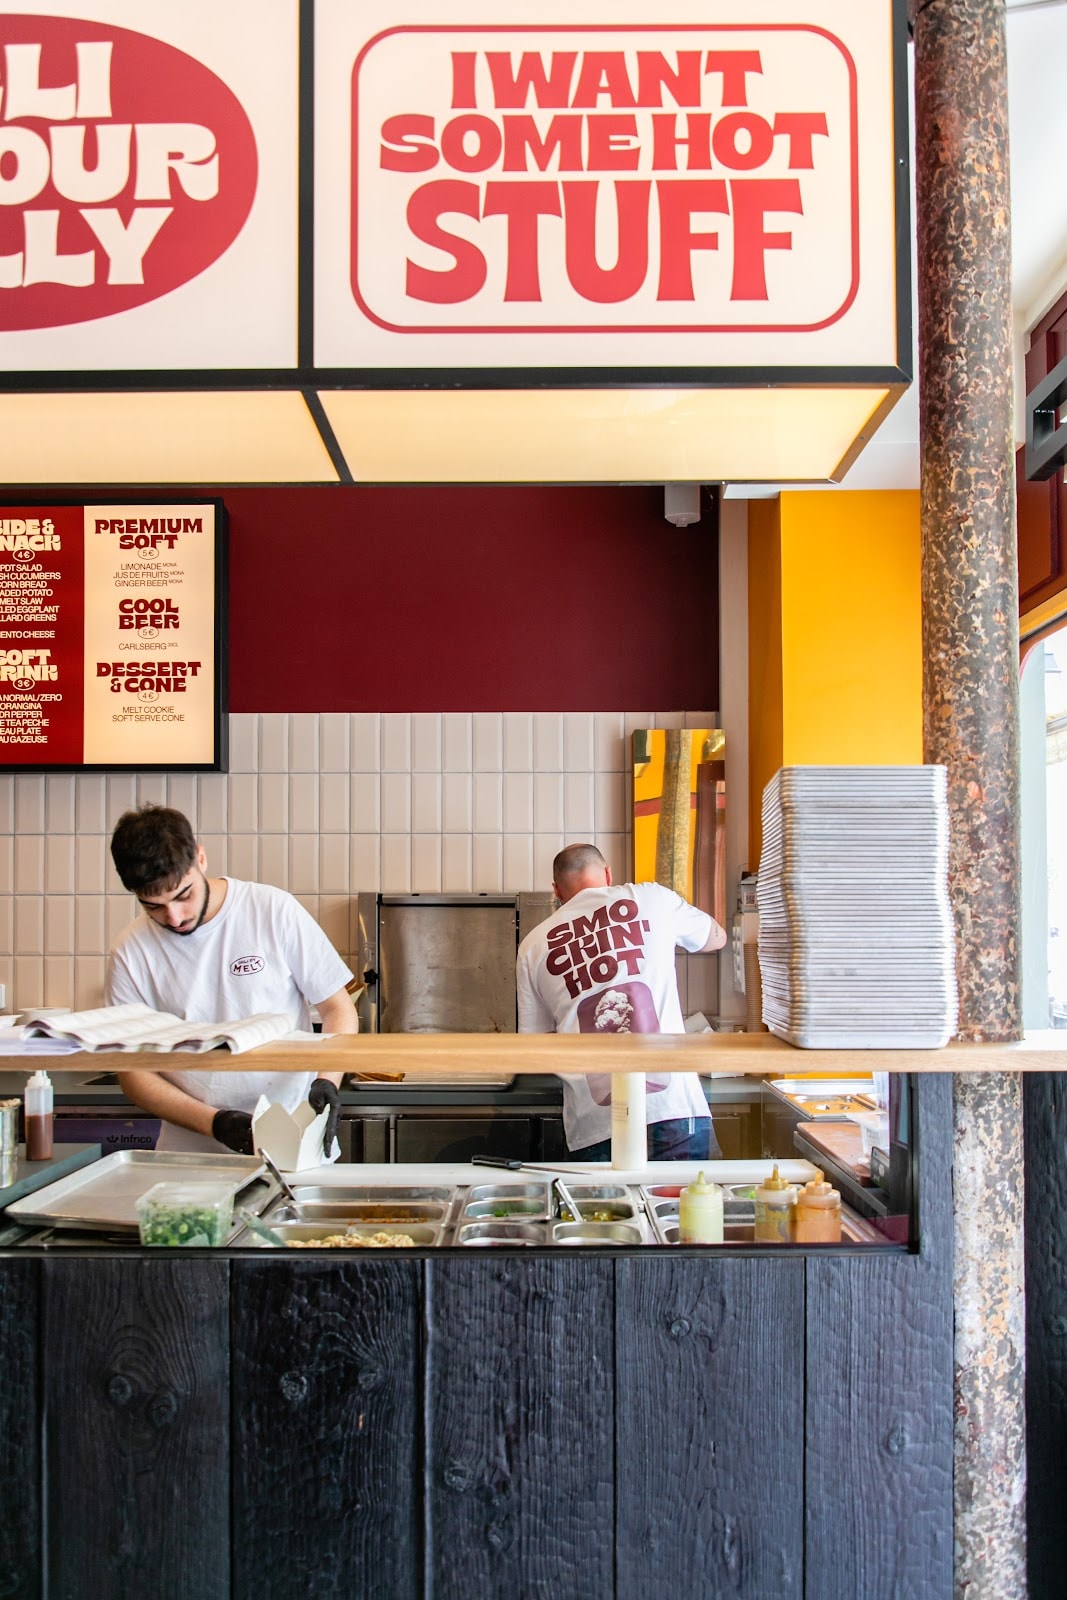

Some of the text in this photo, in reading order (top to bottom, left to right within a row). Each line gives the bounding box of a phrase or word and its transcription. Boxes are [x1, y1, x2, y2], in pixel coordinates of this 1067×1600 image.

[0, 41, 113, 122] LI
[451, 50, 763, 109] I WANT
[380, 112, 830, 173] SOME HOT
[405, 178, 804, 304] STUFF
[0, 519, 55, 535] IDE &
[95, 518, 202, 534] PREMIUM
[120, 534, 178, 550] SOFT
[10, 572, 61, 580] CUCUMBERS
[20, 580, 47, 588] BREAD
[22, 589, 53, 597] POTATO
[17, 606, 60, 614] EGGPLANT
[118, 598, 179, 614] COOL
[118, 614, 180, 630] BEER
[0, 666, 58, 681] RINK
[96, 662, 202, 678] DESSERT
[110, 678, 187, 692] & CONE
[547, 899, 639, 950] SMO
[546, 920, 651, 976] CKIN'
[233, 960, 262, 972] MELT
[564, 948, 645, 999] HOT
[120, 1134, 152, 1144] Infrico
